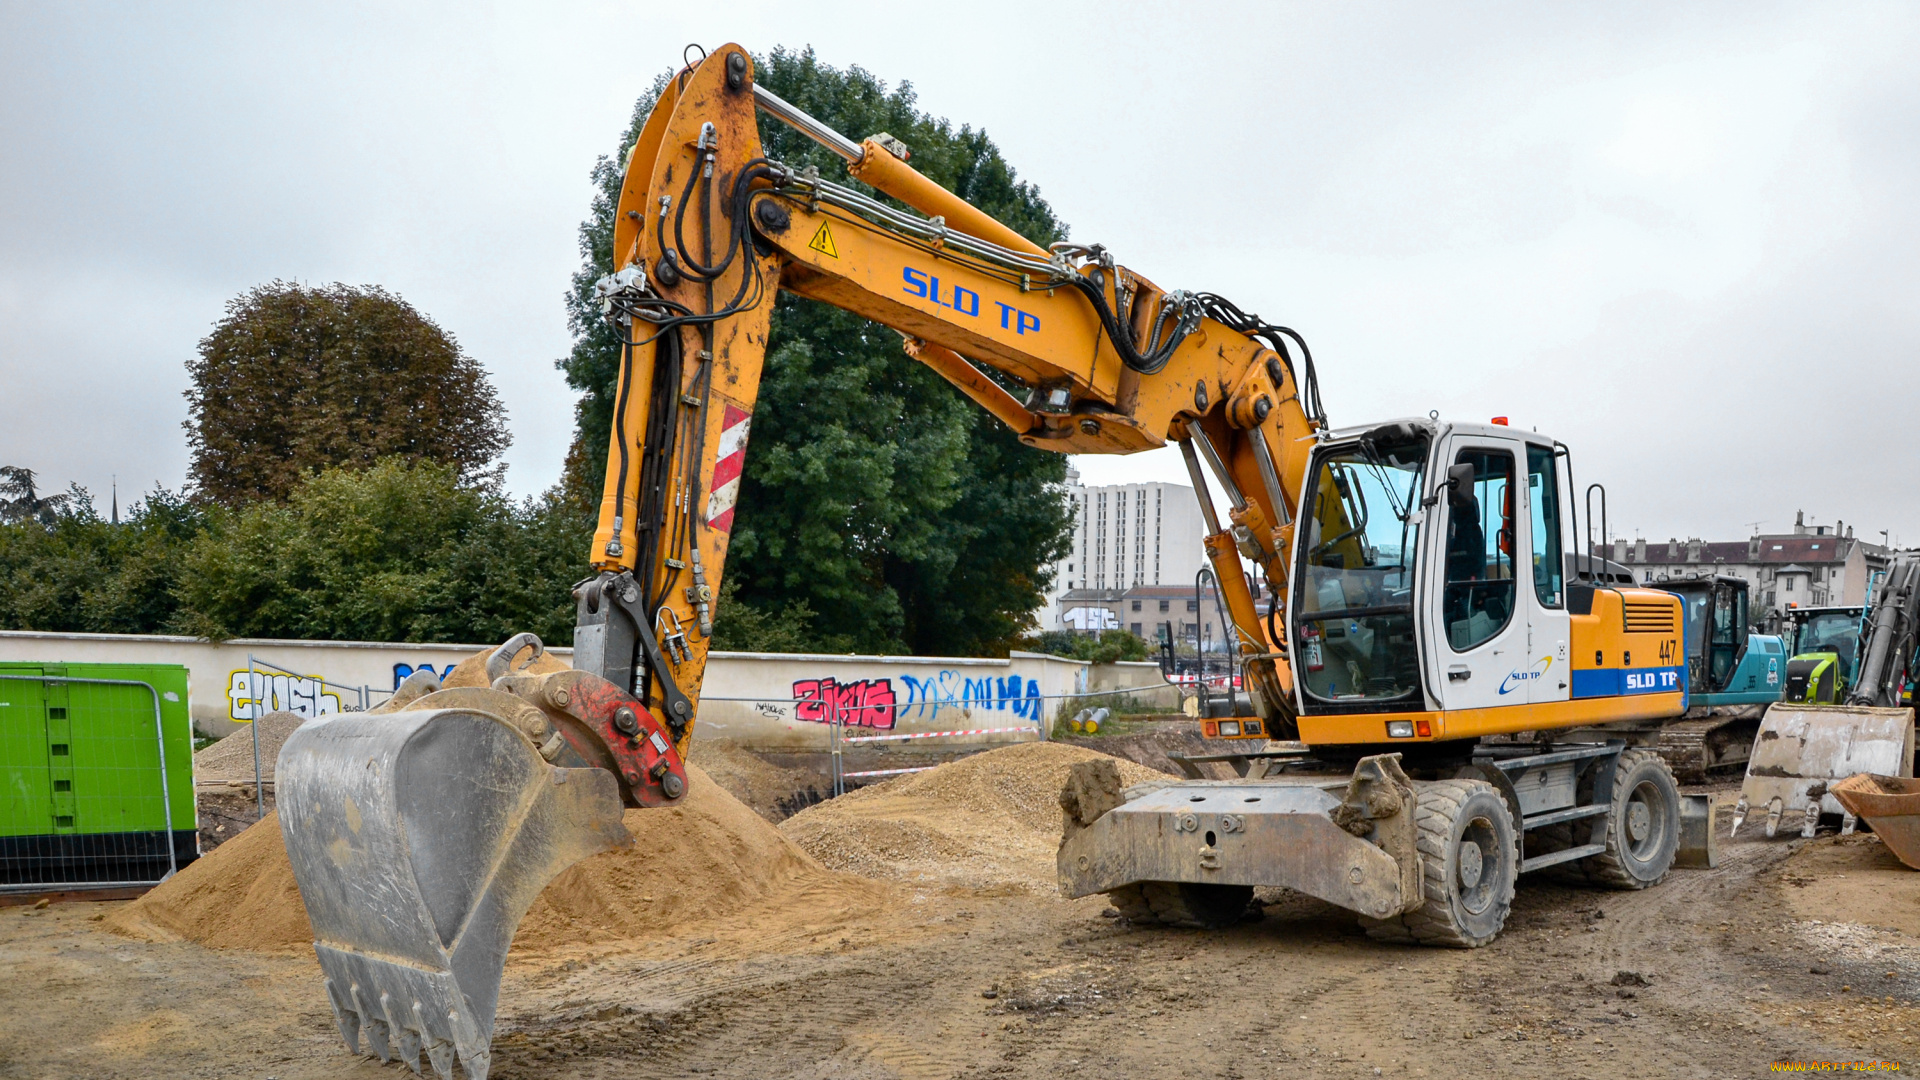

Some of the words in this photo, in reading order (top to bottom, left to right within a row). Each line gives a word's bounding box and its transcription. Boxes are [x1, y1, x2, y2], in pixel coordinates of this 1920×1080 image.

[903, 266, 979, 317] SLD
[995, 300, 1040, 335] TP
[1659, 639, 1676, 666] 447
[1511, 672, 1528, 680] SLD
[1530, 671, 1540, 679] TP
[1626, 672, 1656, 690] SLD
[1659, 671, 1678, 687] TP
